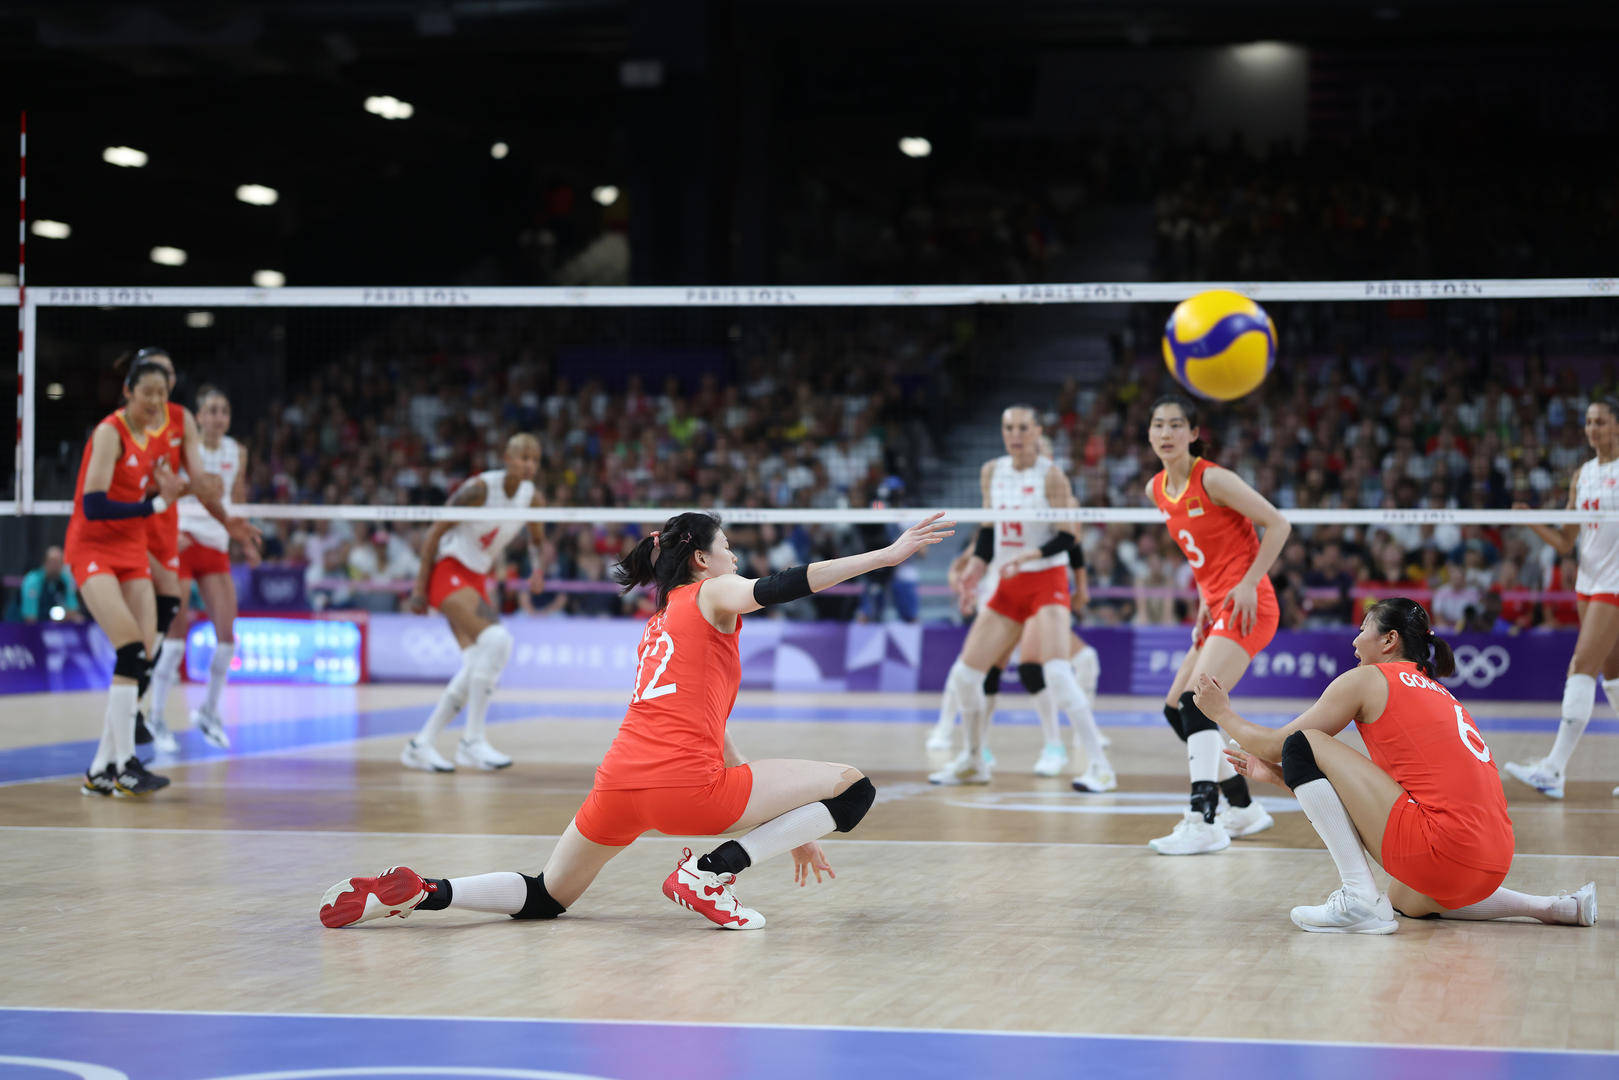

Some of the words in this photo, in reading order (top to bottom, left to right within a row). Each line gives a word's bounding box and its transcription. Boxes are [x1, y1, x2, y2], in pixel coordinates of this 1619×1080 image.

[51, 288, 99, 303] PARIS
[108, 288, 155, 303] 2024
[363, 288, 416, 303] PARIS
[423, 288, 471, 303] 2024
[687, 287, 739, 302] PARIS
[749, 287, 797, 302] 2024
[1019, 284, 1074, 299] PARIS
[1083, 284, 1133, 299] 2024
[1365, 282, 1422, 298] PARIS
[1432, 282, 1484, 298] 2024
[1178, 528, 1206, 569] 3
[633, 631, 677, 703] 12
[1253, 652, 1337, 678] 2024
[1453, 704, 1491, 763] 6
